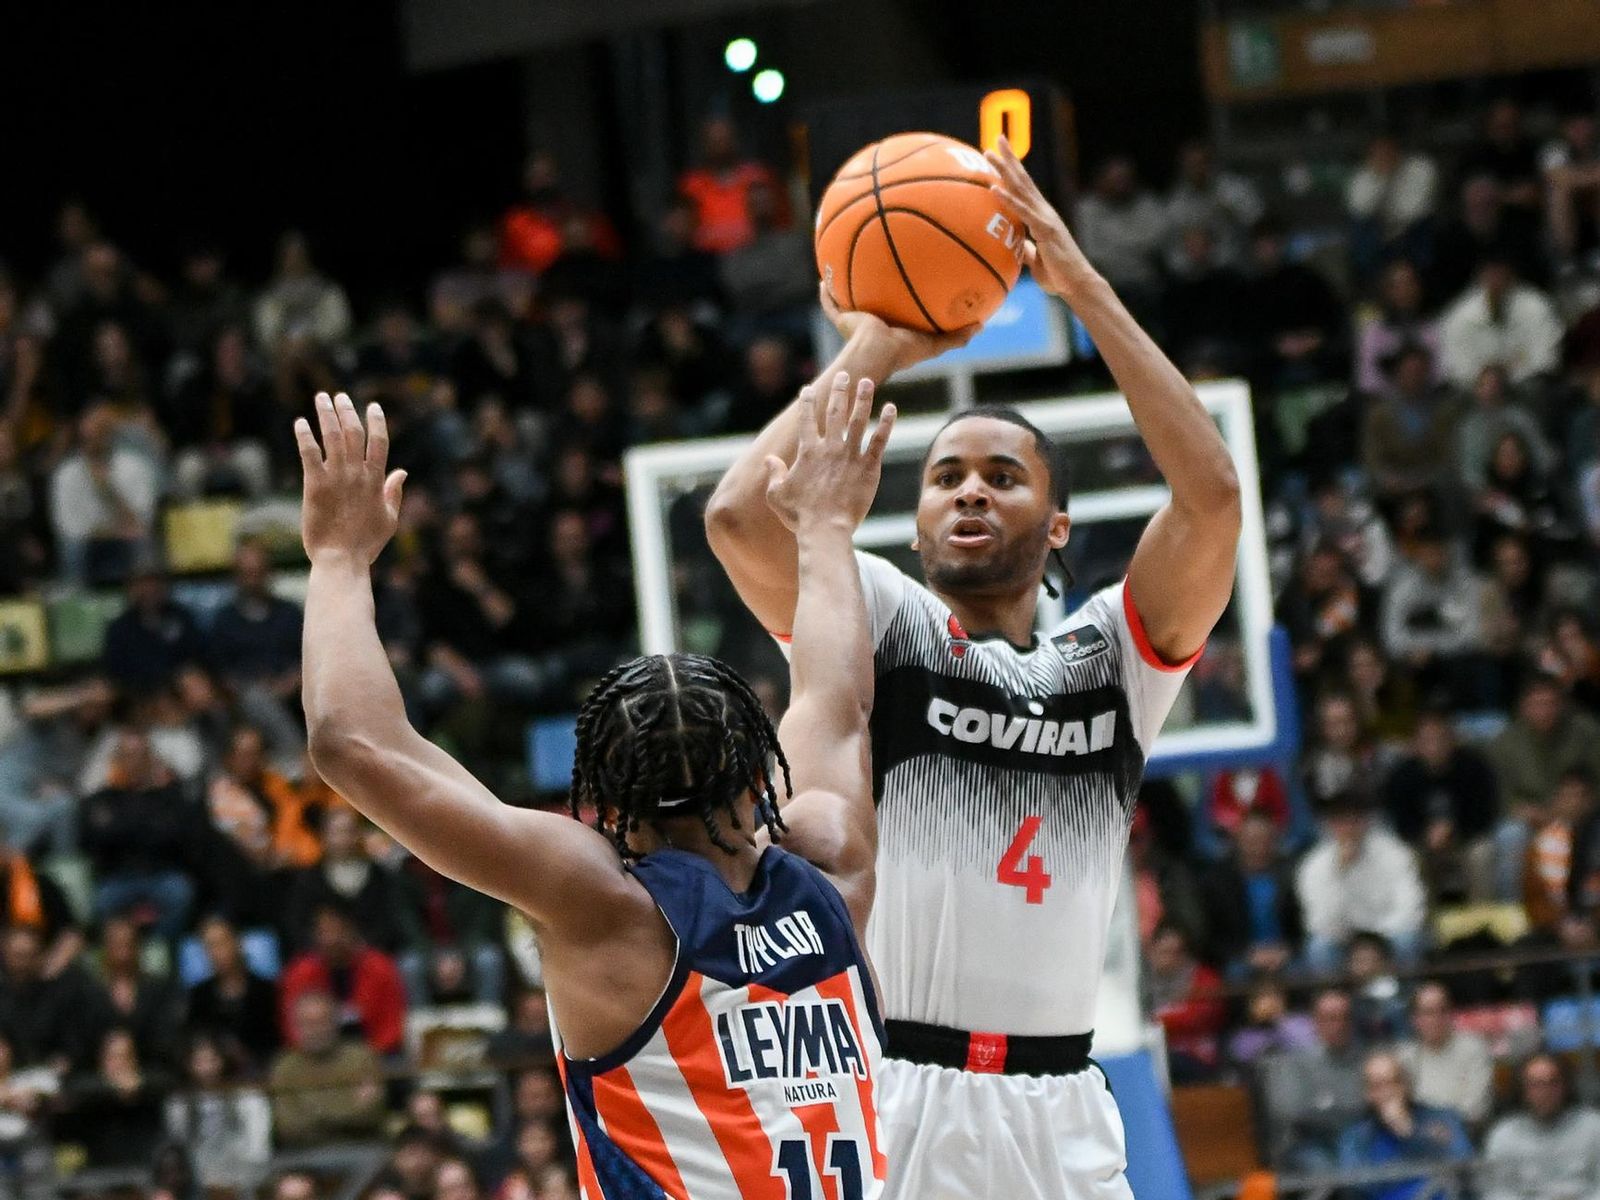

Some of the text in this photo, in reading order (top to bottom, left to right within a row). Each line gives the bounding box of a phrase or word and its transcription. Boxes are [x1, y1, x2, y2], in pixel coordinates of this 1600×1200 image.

[997, 816, 1051, 905] 4
[734, 911, 825, 974] TAYLOR
[717, 1003, 865, 1083] LEYMA
[784, 1082, 837, 1102] NATURA
